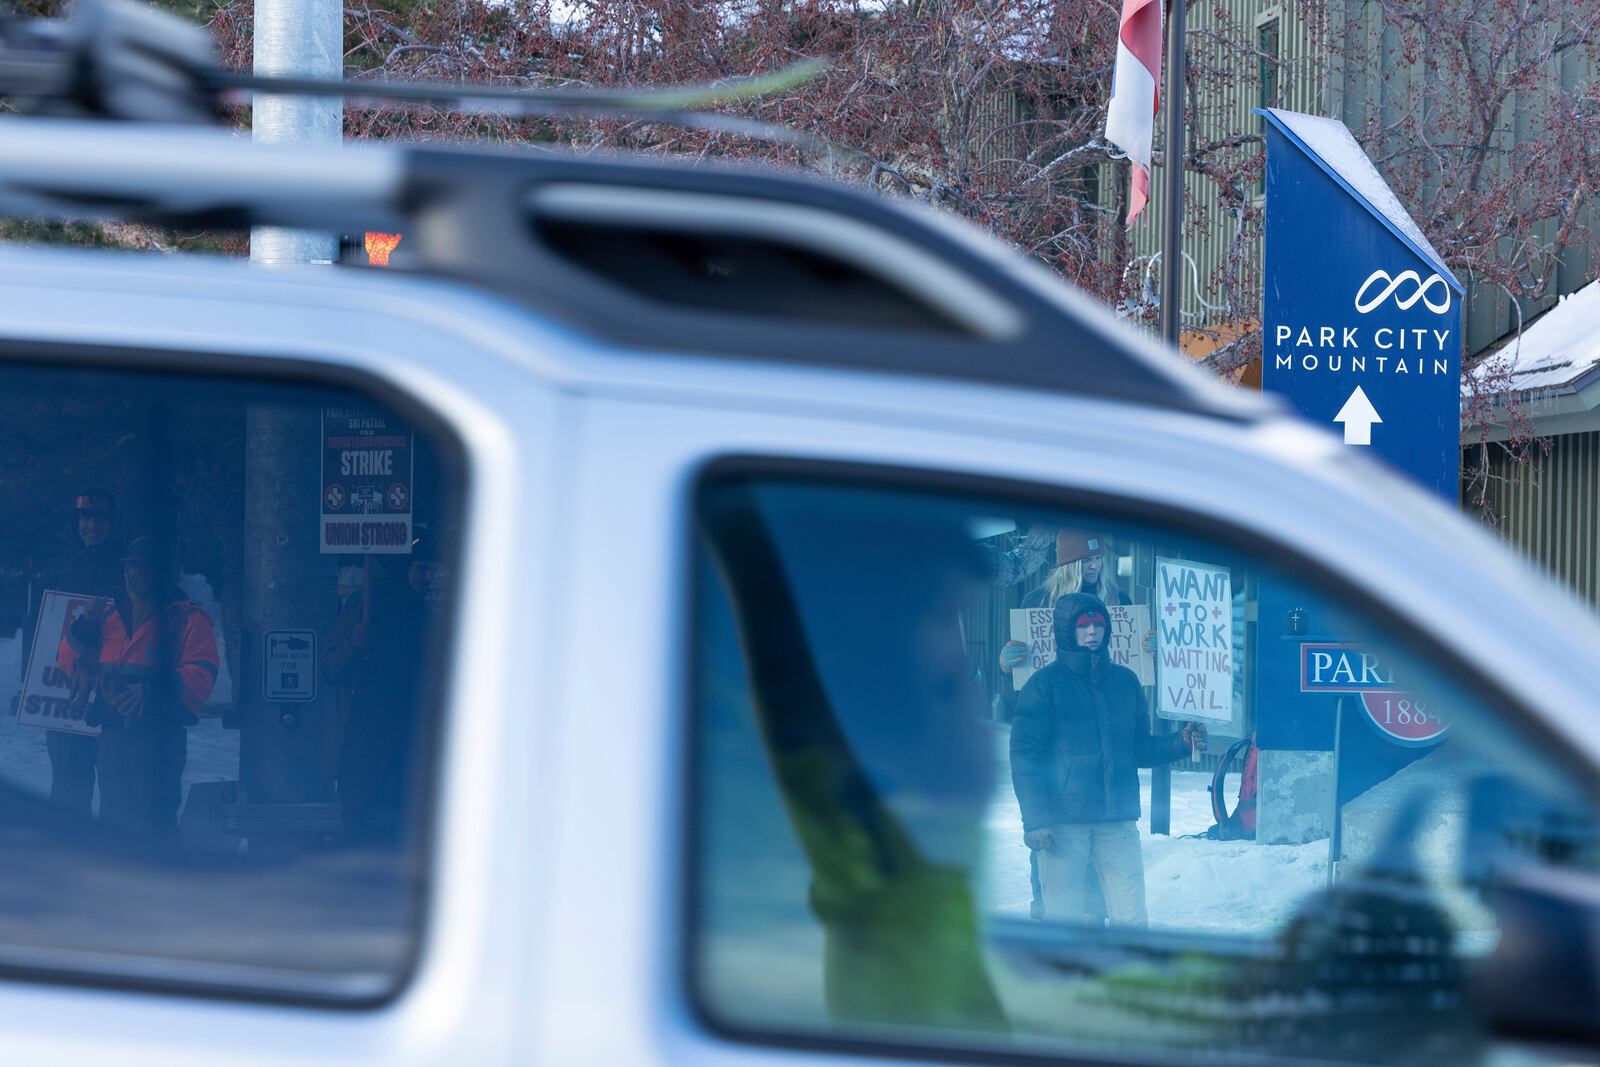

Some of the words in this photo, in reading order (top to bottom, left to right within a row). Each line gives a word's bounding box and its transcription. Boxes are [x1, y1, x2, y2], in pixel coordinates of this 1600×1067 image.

[1276, 325, 1359, 348] PARK
[1374, 328, 1450, 351] CITY
[1275, 353, 1448, 375] MOUNTAIN
[341, 449, 393, 476] STRIKE
[325, 522, 360, 546] UNION
[361, 522, 408, 546] STRONG
[1161, 565, 1229, 603] WANT
[1029, 609, 1055, 625] ESS
[1178, 601, 1208, 623] TO
[1160, 619, 1229, 650] WORK
[1161, 649, 1232, 676] WAITING
[1311, 652, 1396, 684] PAR
[1186, 673, 1207, 690] ON
[1167, 686, 1229, 710] VAIL.
